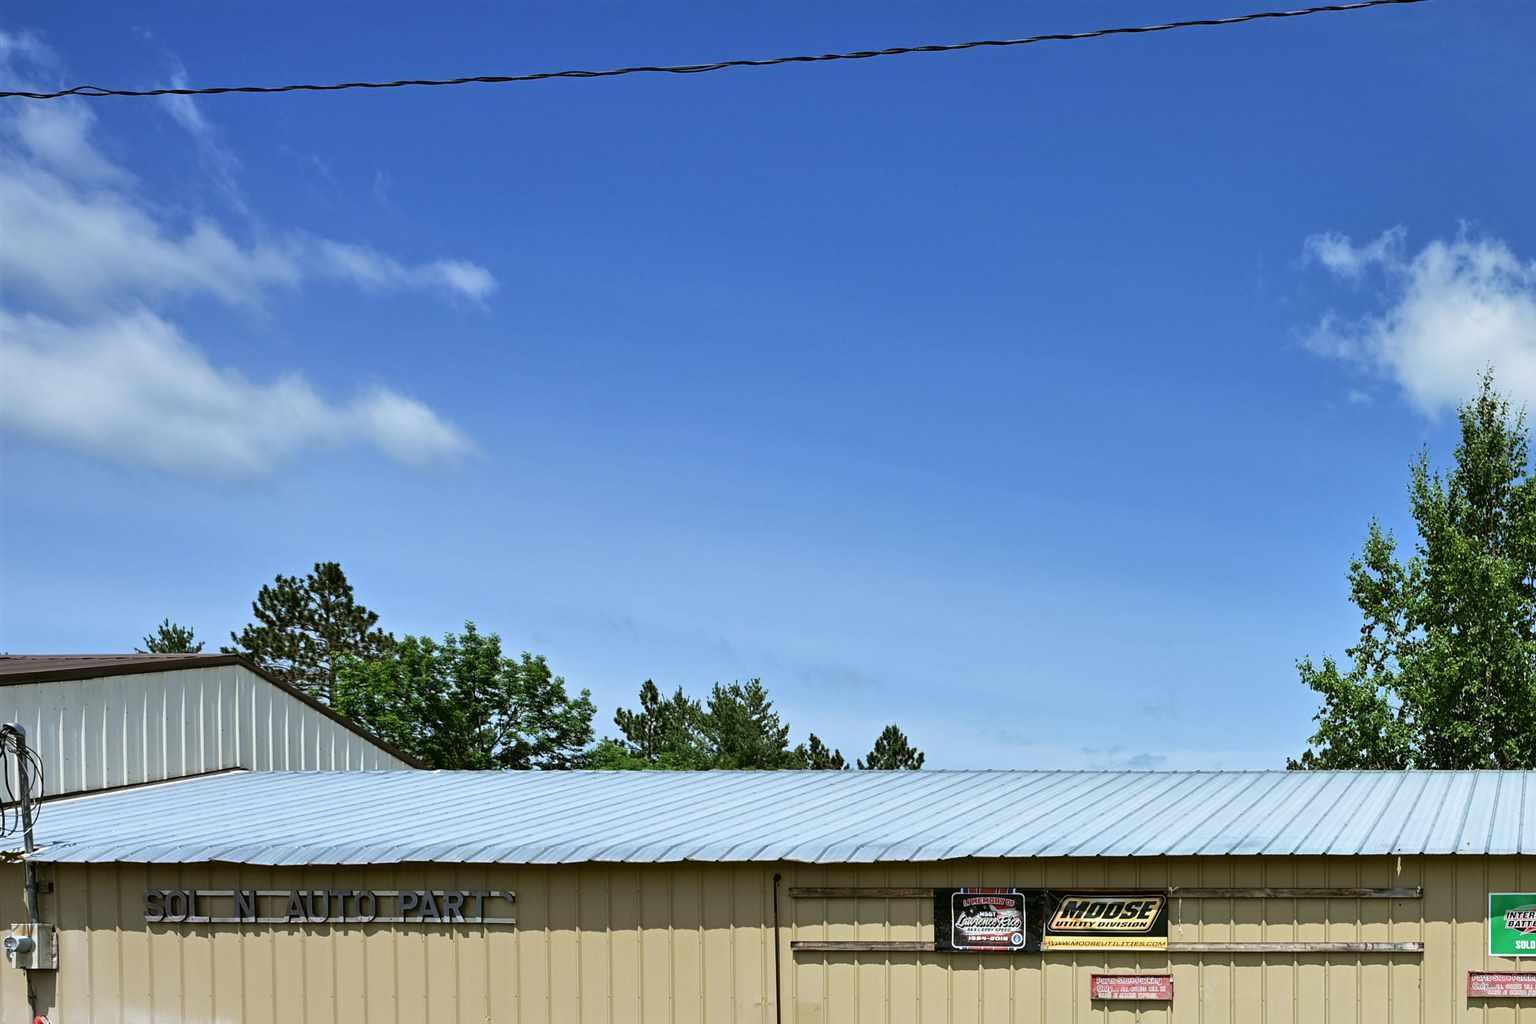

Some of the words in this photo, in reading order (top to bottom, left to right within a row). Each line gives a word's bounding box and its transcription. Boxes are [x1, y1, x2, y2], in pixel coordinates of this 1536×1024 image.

[287, 889, 377, 922] AUTO
[1059, 900, 1158, 919] MOOSE
[1515, 940, 1536, 949] SOLD
